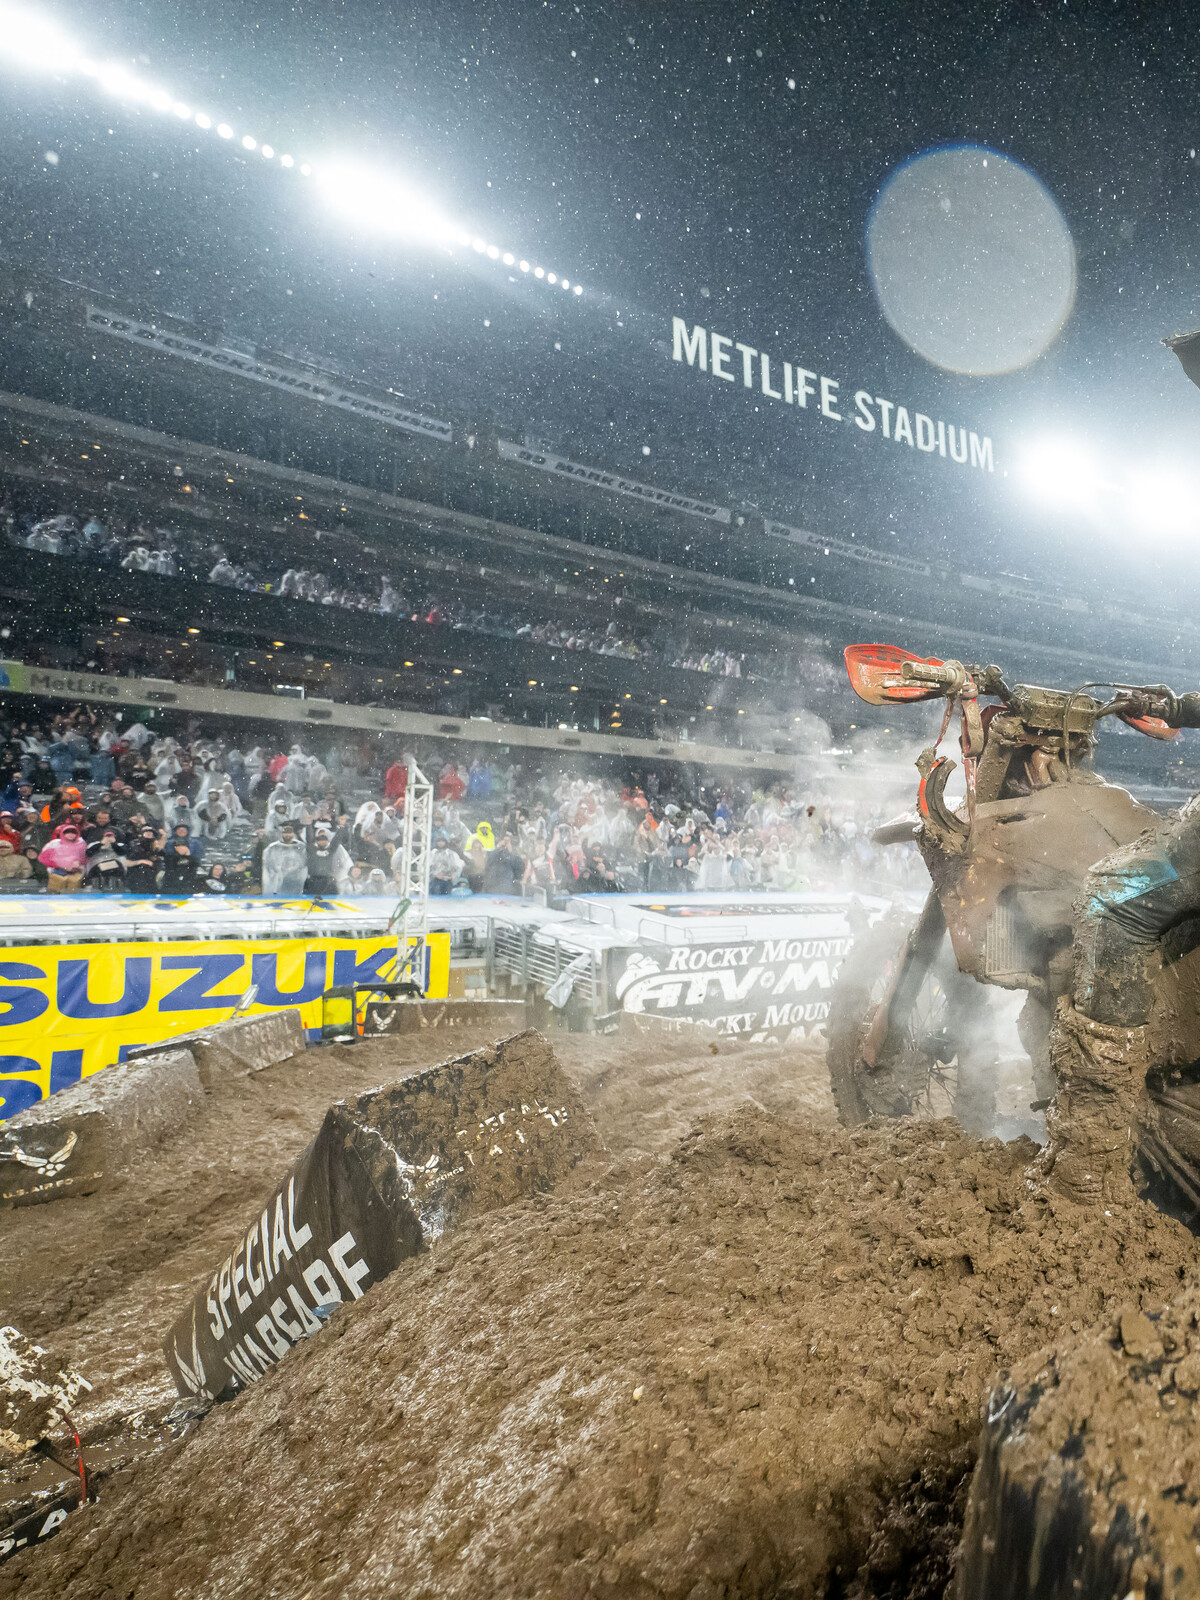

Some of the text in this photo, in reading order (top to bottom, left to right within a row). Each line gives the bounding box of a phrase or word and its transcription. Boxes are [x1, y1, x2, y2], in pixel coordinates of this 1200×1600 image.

[671, 316, 995, 473] METLIFE STADIUM
[30, 673, 120, 697] MetLife
[665, 938, 855, 972] ROCKY MOUNTA
[760, 1002, 832, 1029] MOUN
[206, 1176, 313, 1341] SPECIAL
